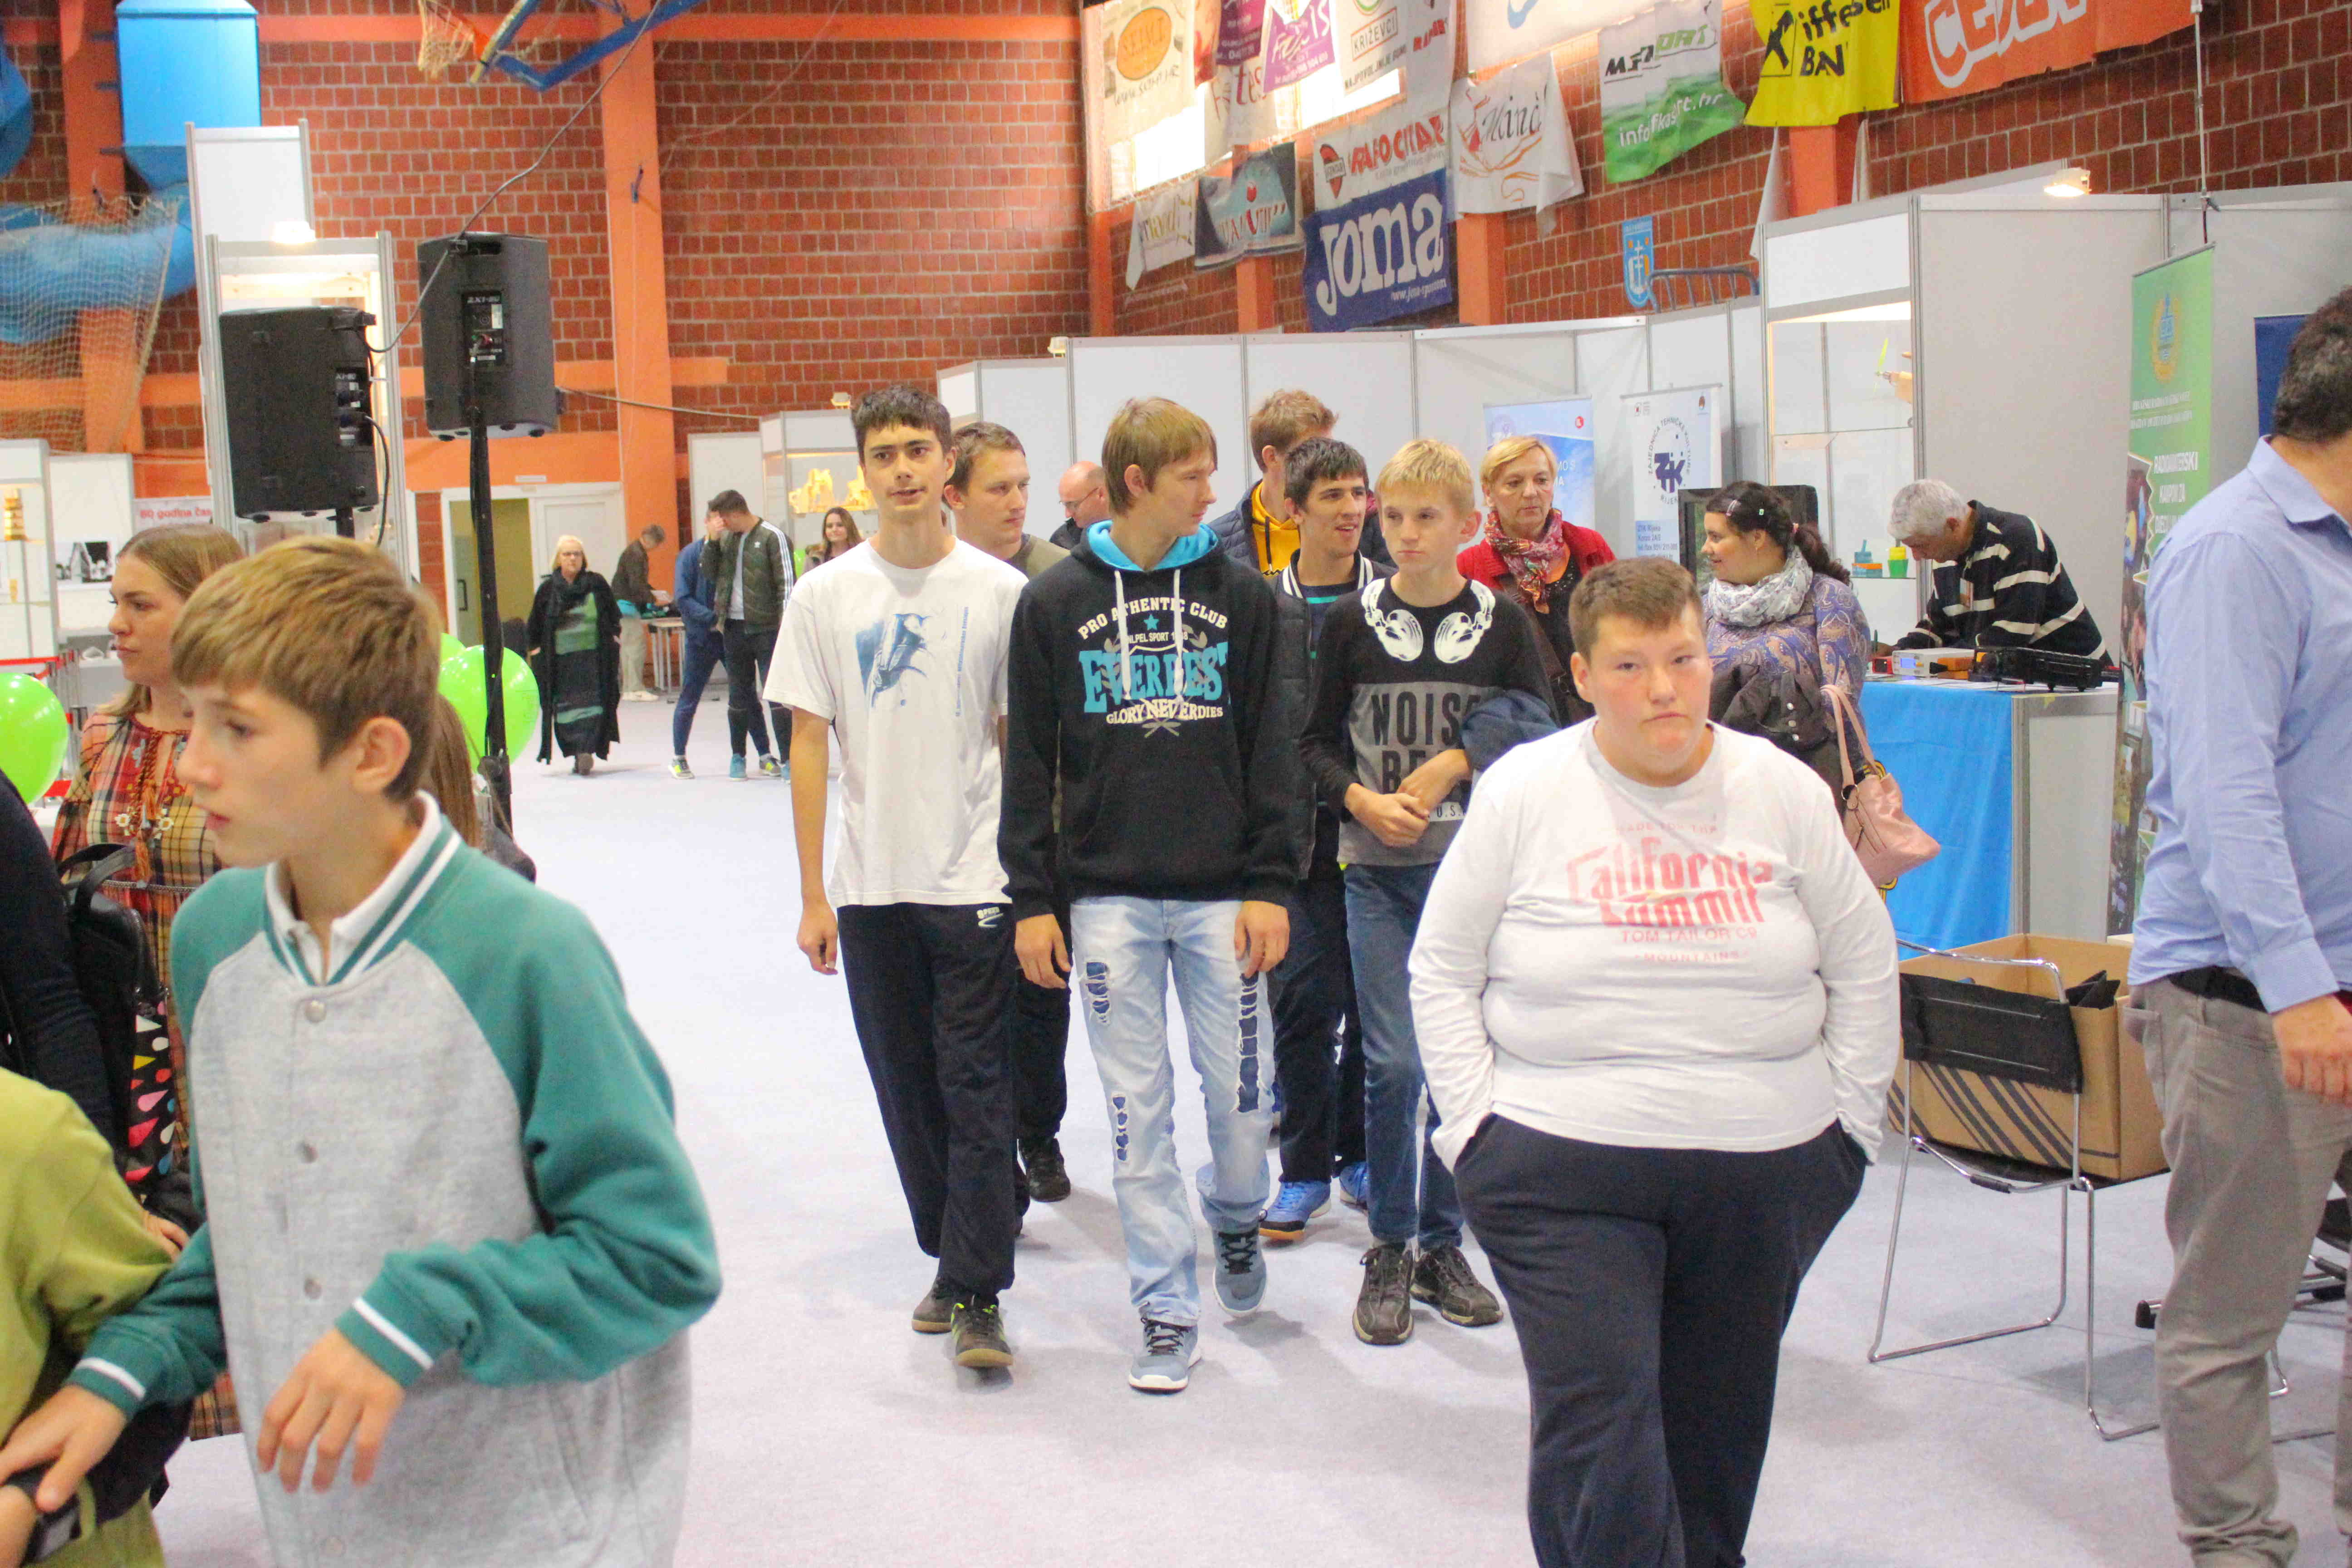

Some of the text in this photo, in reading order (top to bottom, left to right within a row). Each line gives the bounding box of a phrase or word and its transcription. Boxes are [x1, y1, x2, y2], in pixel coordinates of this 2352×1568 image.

[1353, 15, 1396, 55] KRIŽEVCI
[1078, 612, 1108, 640] PRO
[1190, 602, 1228, 629] CLUB
[1149, 631, 1170, 642] SPORT
[1106, 698, 1224, 724] GLORY NEVER DIES
[1565, 835, 1773, 904] California
[1622, 929, 1659, 942] TOM
[1666, 927, 1731, 942] TAILOR
